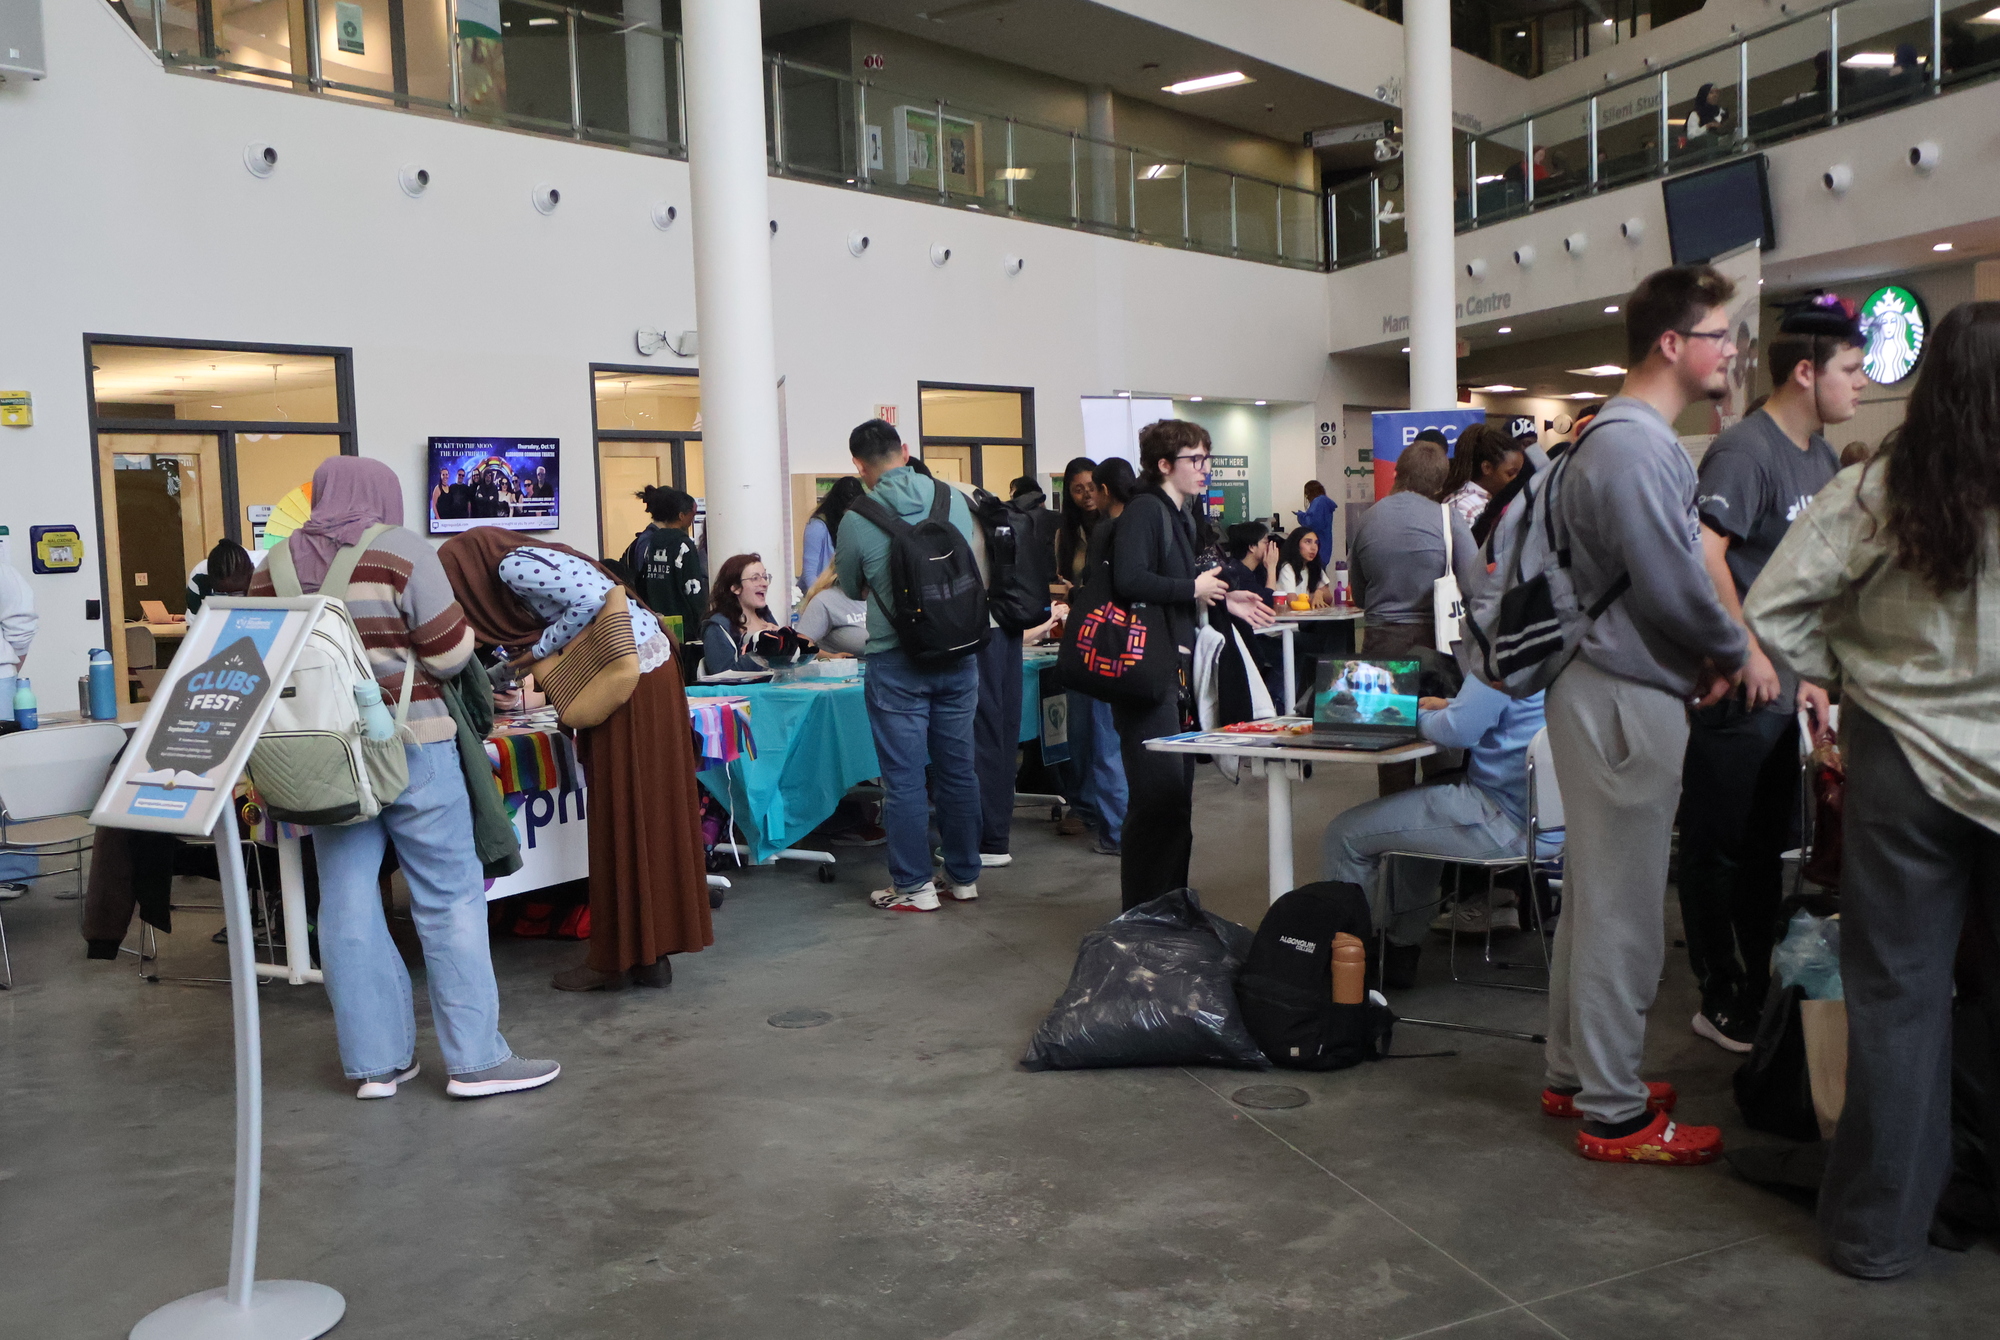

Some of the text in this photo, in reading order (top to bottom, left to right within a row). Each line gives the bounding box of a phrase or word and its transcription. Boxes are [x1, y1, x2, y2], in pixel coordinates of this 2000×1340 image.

[1466, 292, 1511, 316] Centre
[880, 406, 896, 424] EXIT
[1402, 424, 1458, 446] BC
[1229, 457, 1244, 466] HERE
[187, 669, 262, 695] CLUBS
[190, 694, 239, 711] FEST
[1279, 935, 1317, 948] ALGONQUIN
